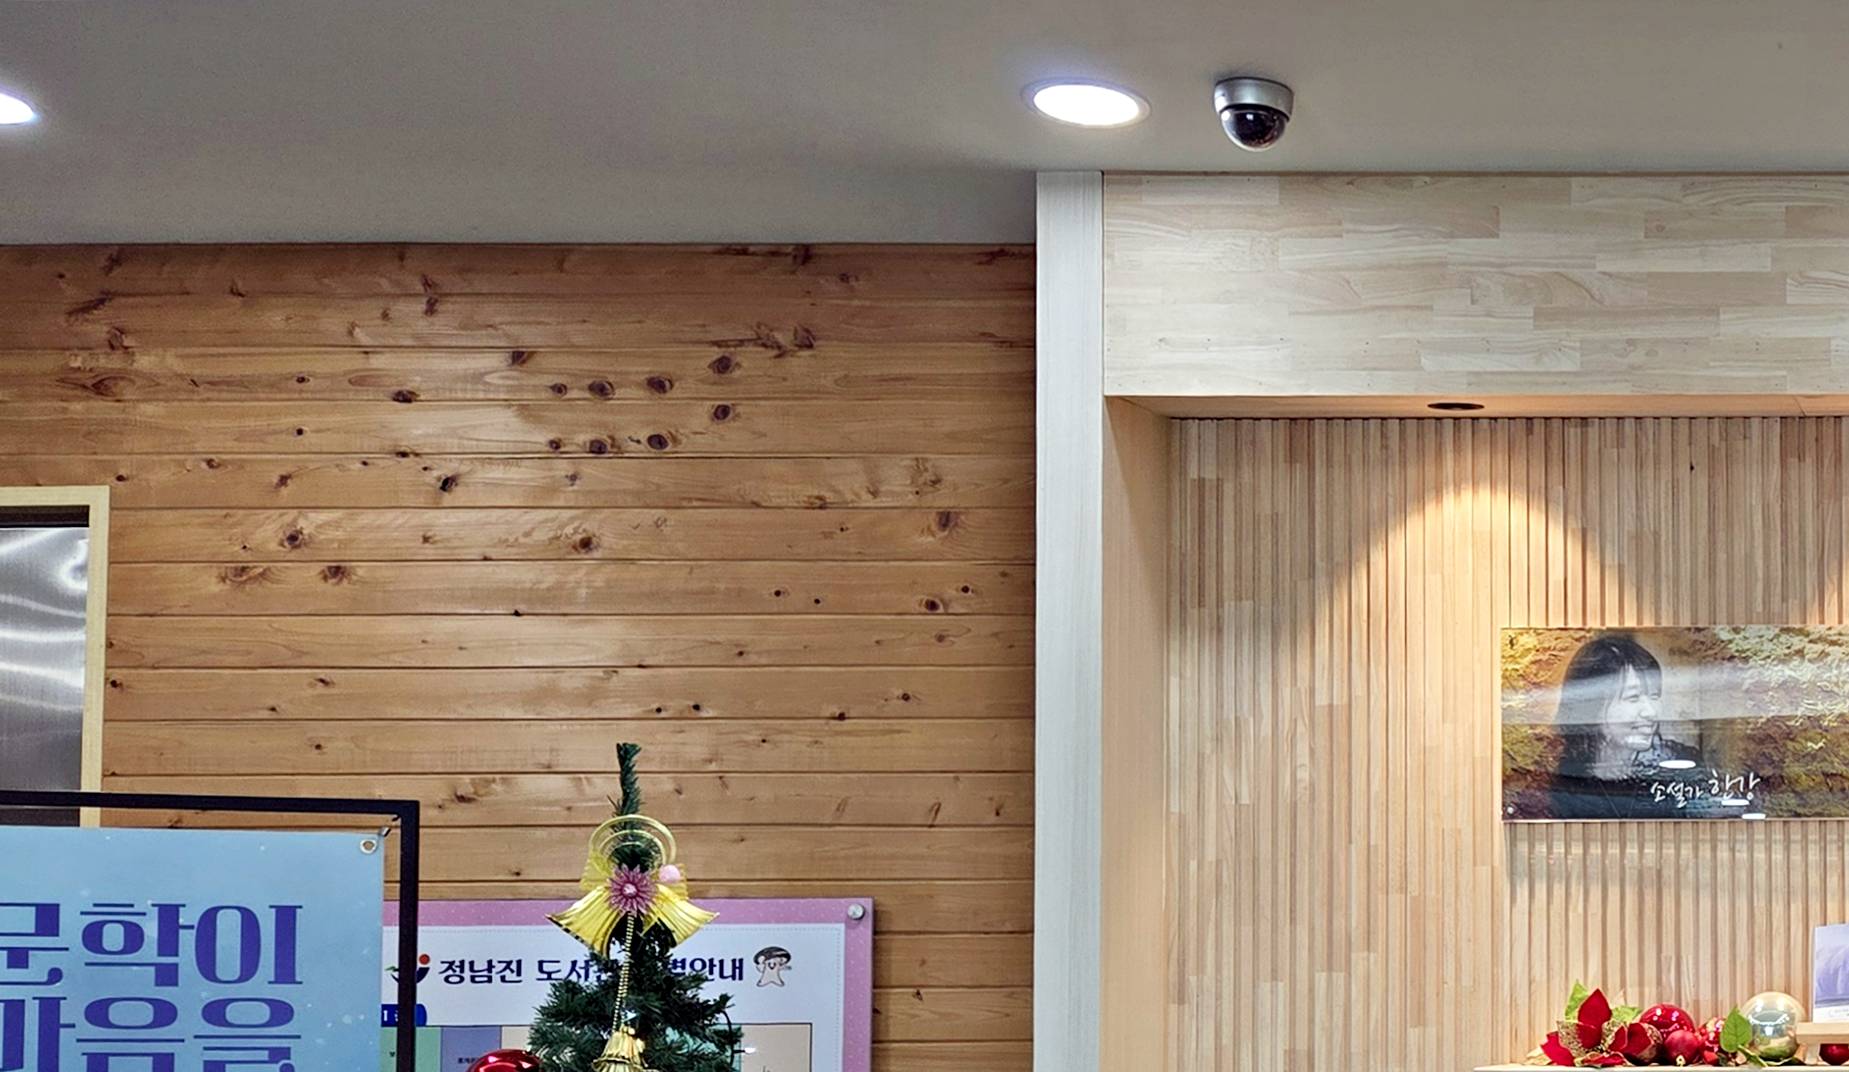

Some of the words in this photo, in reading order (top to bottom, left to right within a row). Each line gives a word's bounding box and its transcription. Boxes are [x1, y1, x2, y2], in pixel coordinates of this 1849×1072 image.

[1650, 781, 1704, 808] 소설가
[1707, 769, 1761, 801] 한강
[439, 959, 523, 985] 정남진
